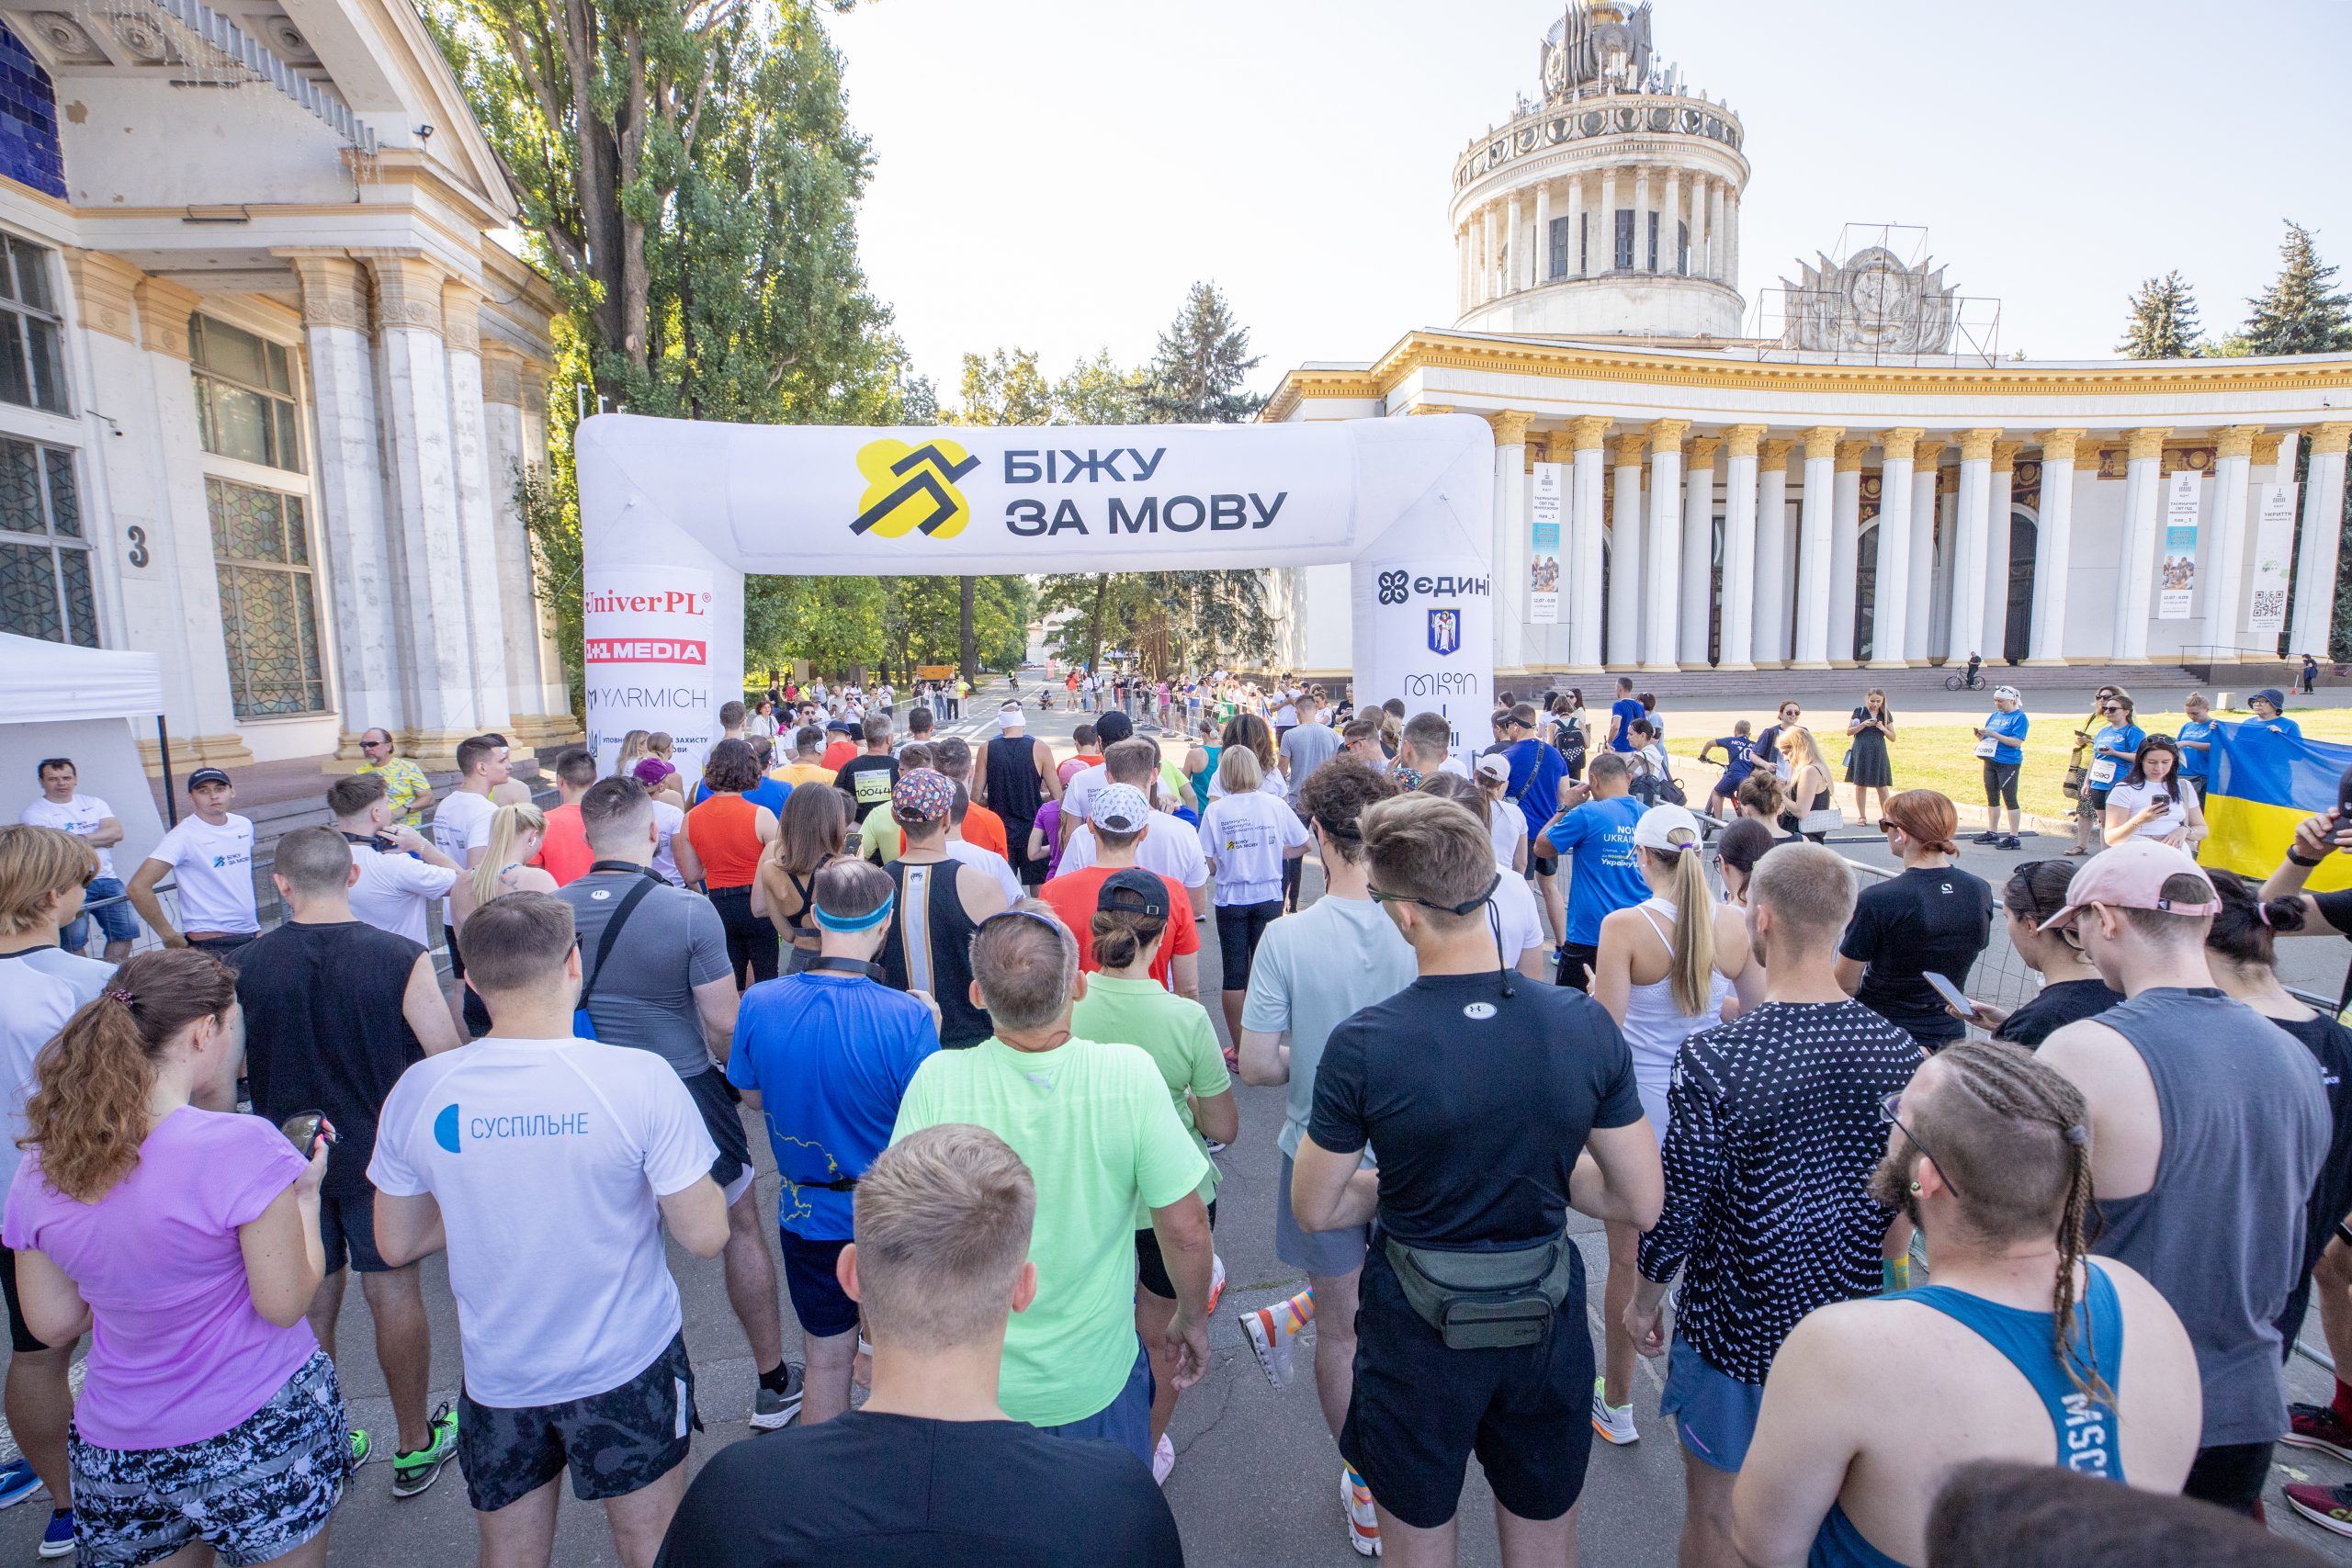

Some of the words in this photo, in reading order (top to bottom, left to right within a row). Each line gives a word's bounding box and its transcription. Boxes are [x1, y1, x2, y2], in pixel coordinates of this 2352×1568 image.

[1004, 447, 1167, 484] БІЖУ
[1006, 499, 1090, 536] ЗА
[1109, 492, 1288, 535] МОВУ
[128, 525, 150, 569] 3
[614, 642, 702, 660] MEDIA
[602, 687, 707, 708] YARMICH
[856, 787, 890, 797] 10044
[470, 1112, 589, 1139] СУСПІЛЬНЕ
